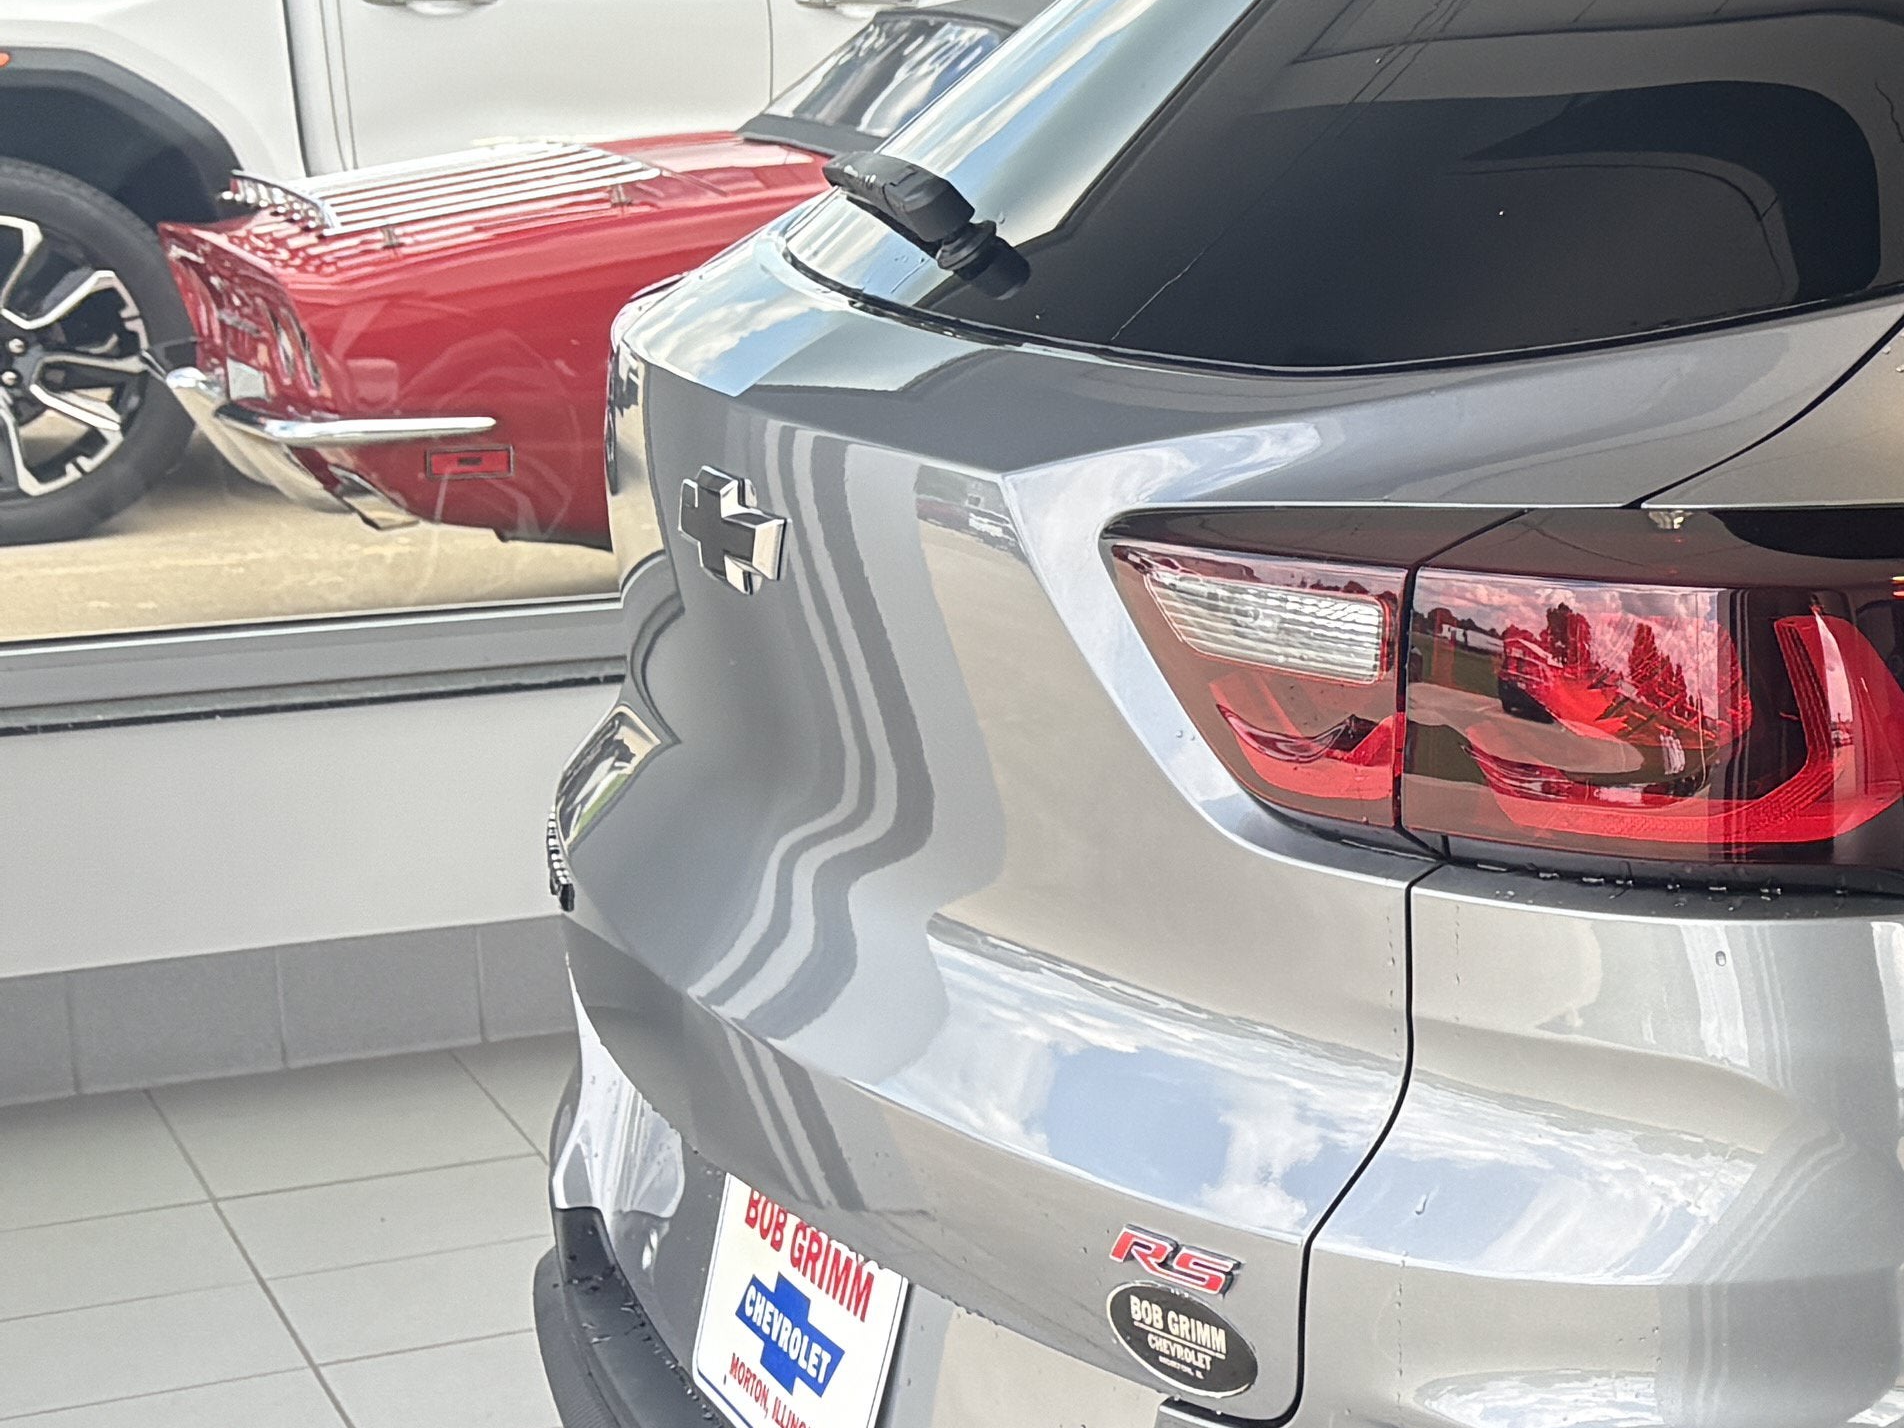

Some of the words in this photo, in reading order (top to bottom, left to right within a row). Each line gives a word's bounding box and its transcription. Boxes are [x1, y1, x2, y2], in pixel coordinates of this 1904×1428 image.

[744, 1187, 788, 1253] BOB
[789, 1221, 875, 1323] GRIMM
[1109, 1224, 1240, 1296] RS
[744, 1284, 832, 1384] CHEVROLET
[1129, 1294, 1164, 1330] BOB
[1167, 1310, 1227, 1354] GRIMM
[1147, 1332, 1212, 1371] CHEVROLET
[729, 1352, 769, 1418] MORTON,
